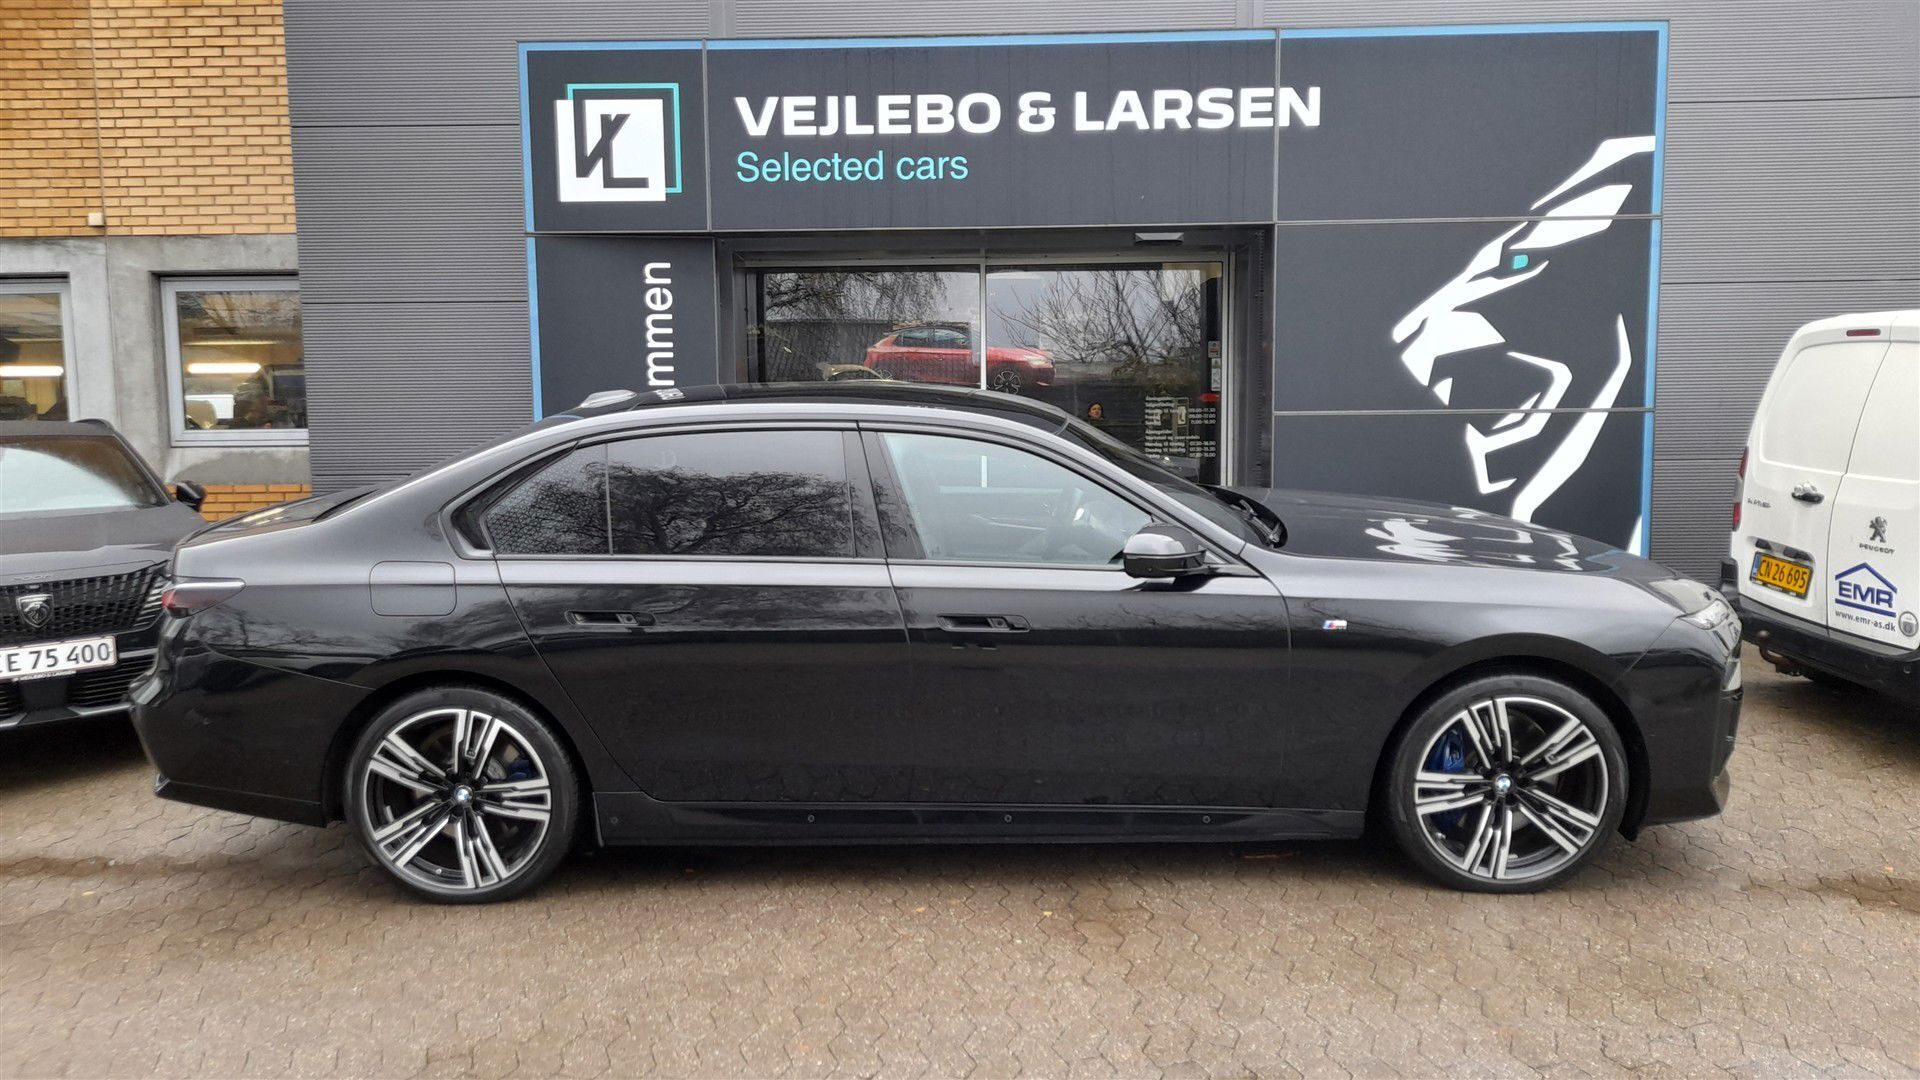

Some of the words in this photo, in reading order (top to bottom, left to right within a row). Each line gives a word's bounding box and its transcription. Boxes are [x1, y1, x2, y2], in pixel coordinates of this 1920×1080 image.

[735, 93, 1001, 136] VEJLEBO
[1018, 91, 1056, 132] &
[1075, 87, 1322, 131] LARSEN
[736, 150, 884, 182] Selected
[896, 154, 969, 181] cars
[643, 262, 675, 387] mmen
[1859, 543, 1895, 554] PEUGEOT
[1758, 560, 1771, 578] CN
[1773, 564, 1785, 582] 26
[1786, 568, 1807, 588] 695
[1838, 580, 1894, 608] EMR
[1835, 609, 1896, 632] www.emr-as.dk
[0, 653, 21, 673] E
[29, 648, 59, 670] 75
[66, 643, 110, 664] 400
